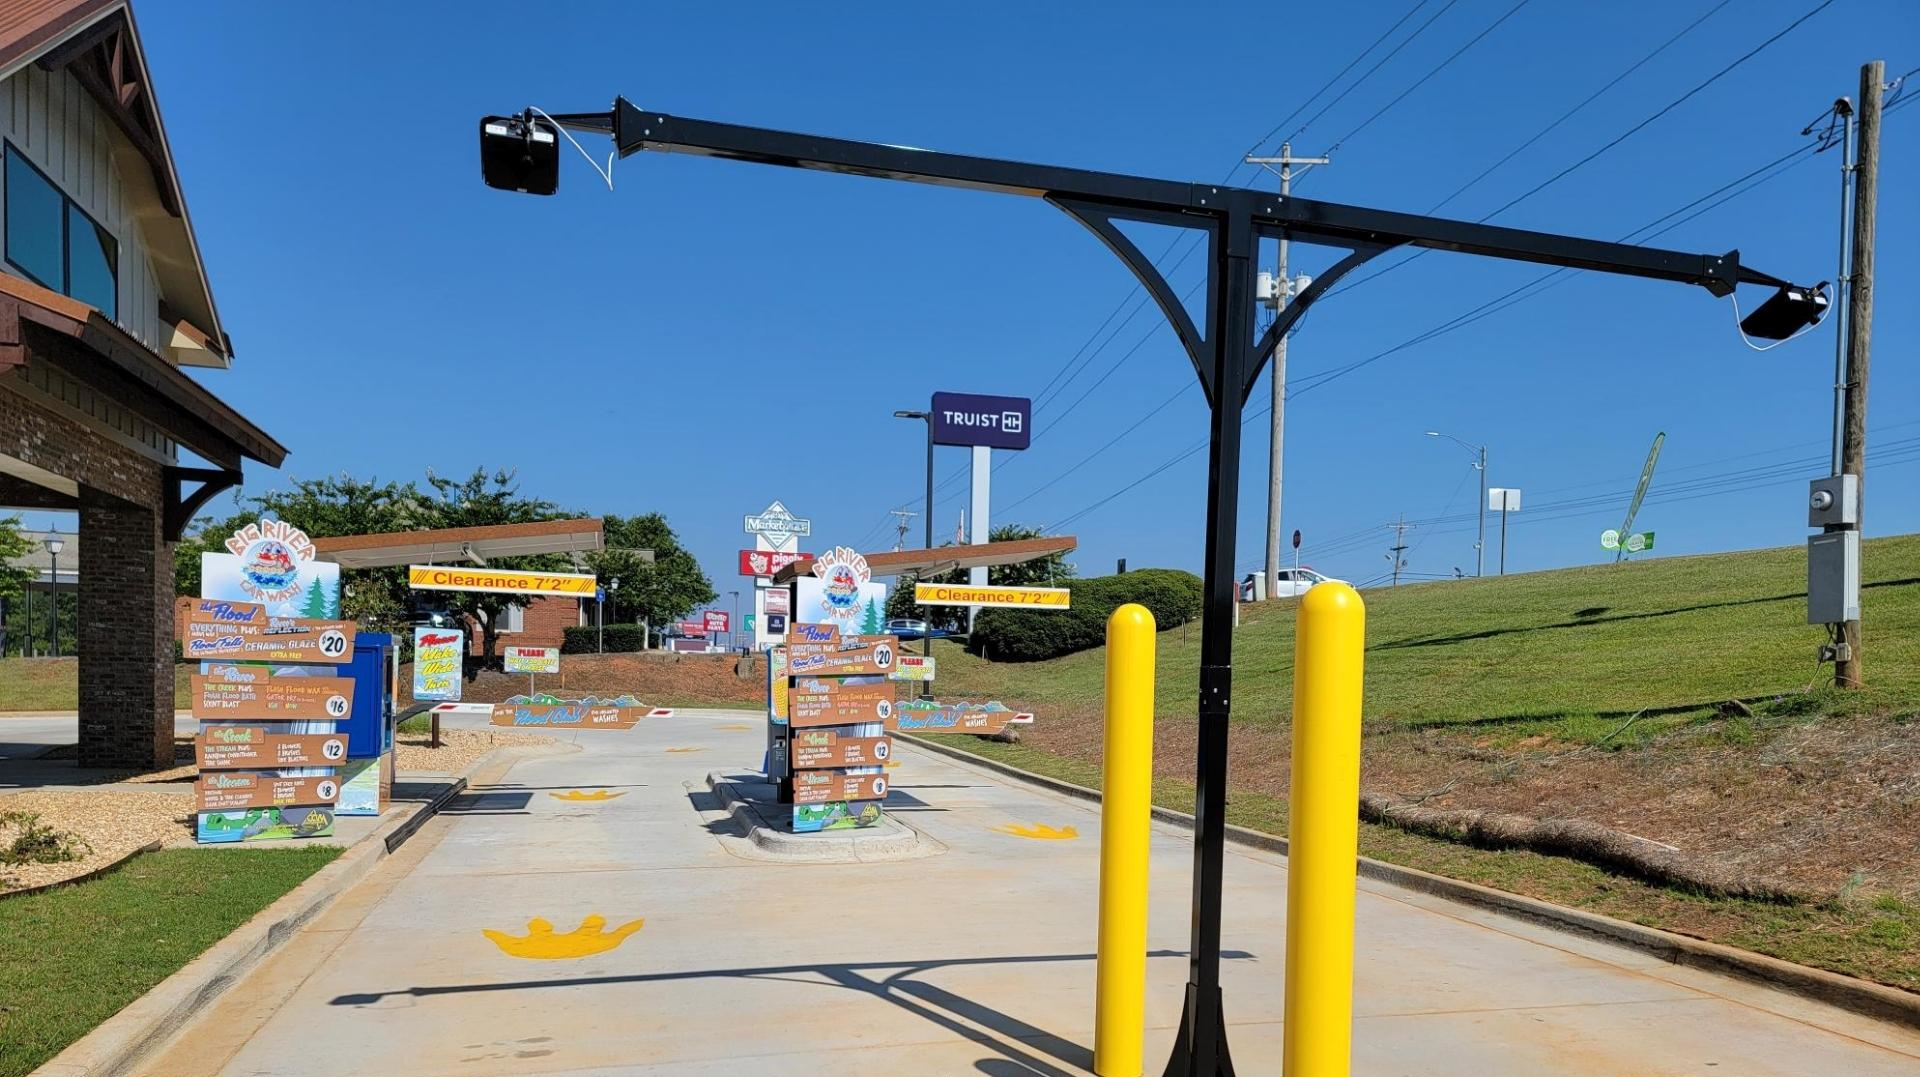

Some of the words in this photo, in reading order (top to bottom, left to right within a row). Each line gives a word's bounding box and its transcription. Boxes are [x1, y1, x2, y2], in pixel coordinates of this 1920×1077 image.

[943, 411, 999, 427] TRUIST
[225, 523, 261, 557] BIG
[262, 519, 316, 561] RIVER
[812, 551, 836, 580] BIG
[836, 546, 871, 583] RIVER
[433, 572, 528, 589] Clearance
[534, 577, 572, 591] 7'2"
[240, 580, 265, 601] CAR
[266, 582, 303, 602] WASH
[936, 588, 1014, 603] Clearance
[213, 603, 258, 623] Flood
[821, 600, 838, 618] CAR
[838, 602, 862, 619] WASH
[190, 623, 238, 634] EVERYTHING
[240, 625, 260, 635] PLUS:
[805, 626, 835, 641] Flood
[245, 641, 286, 652] CERAMIC
[289, 640, 317, 650] GLAZE
[321, 635, 345, 654] $20
[421, 647, 458, 661] Make
[518, 649, 545, 657] PLEASE
[876, 650, 891, 665] $20
[423, 661, 456, 676] Wide
[425, 679, 451, 690] Turn
[330, 701, 344, 713] $16
[514, 708, 554, 725] Flood
[592, 714, 618, 723] WASHES
[965, 719, 988, 728] WASHES
[327, 744, 340, 757] $12
[322, 785, 332, 797] $8
